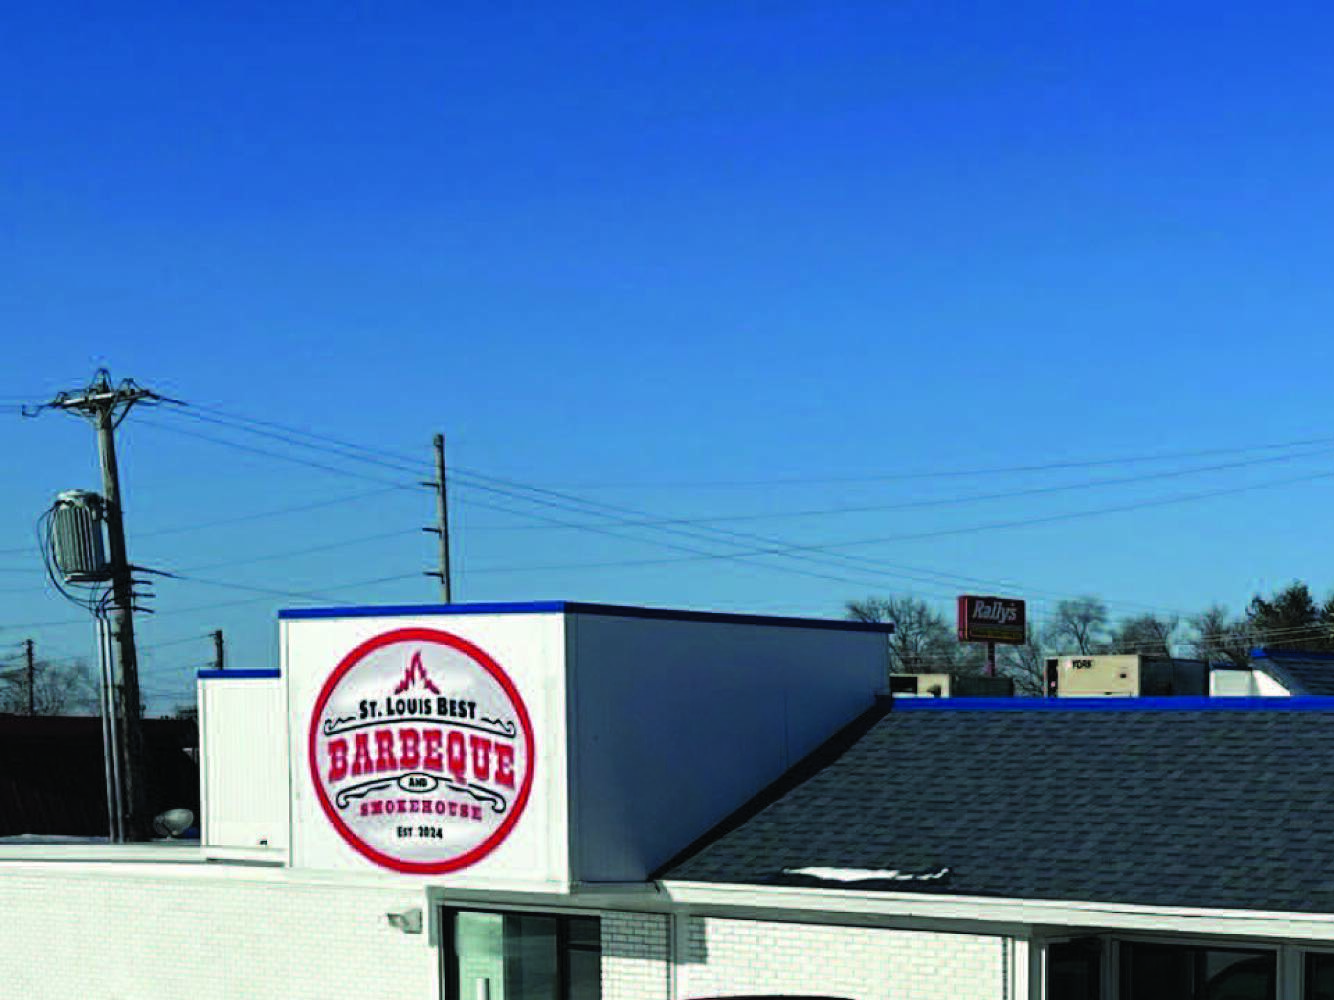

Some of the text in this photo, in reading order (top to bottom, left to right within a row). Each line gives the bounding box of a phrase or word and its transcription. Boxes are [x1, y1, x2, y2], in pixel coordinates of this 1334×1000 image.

[386, 697, 431, 716] LOUIS
[437, 697, 477, 719] BEST
[328, 728, 514, 789] BARBEQUE
[409, 777, 428, 787] AND
[360, 800, 482, 821] SMOKEHOUSE
[418, 827, 443, 839] 2024
